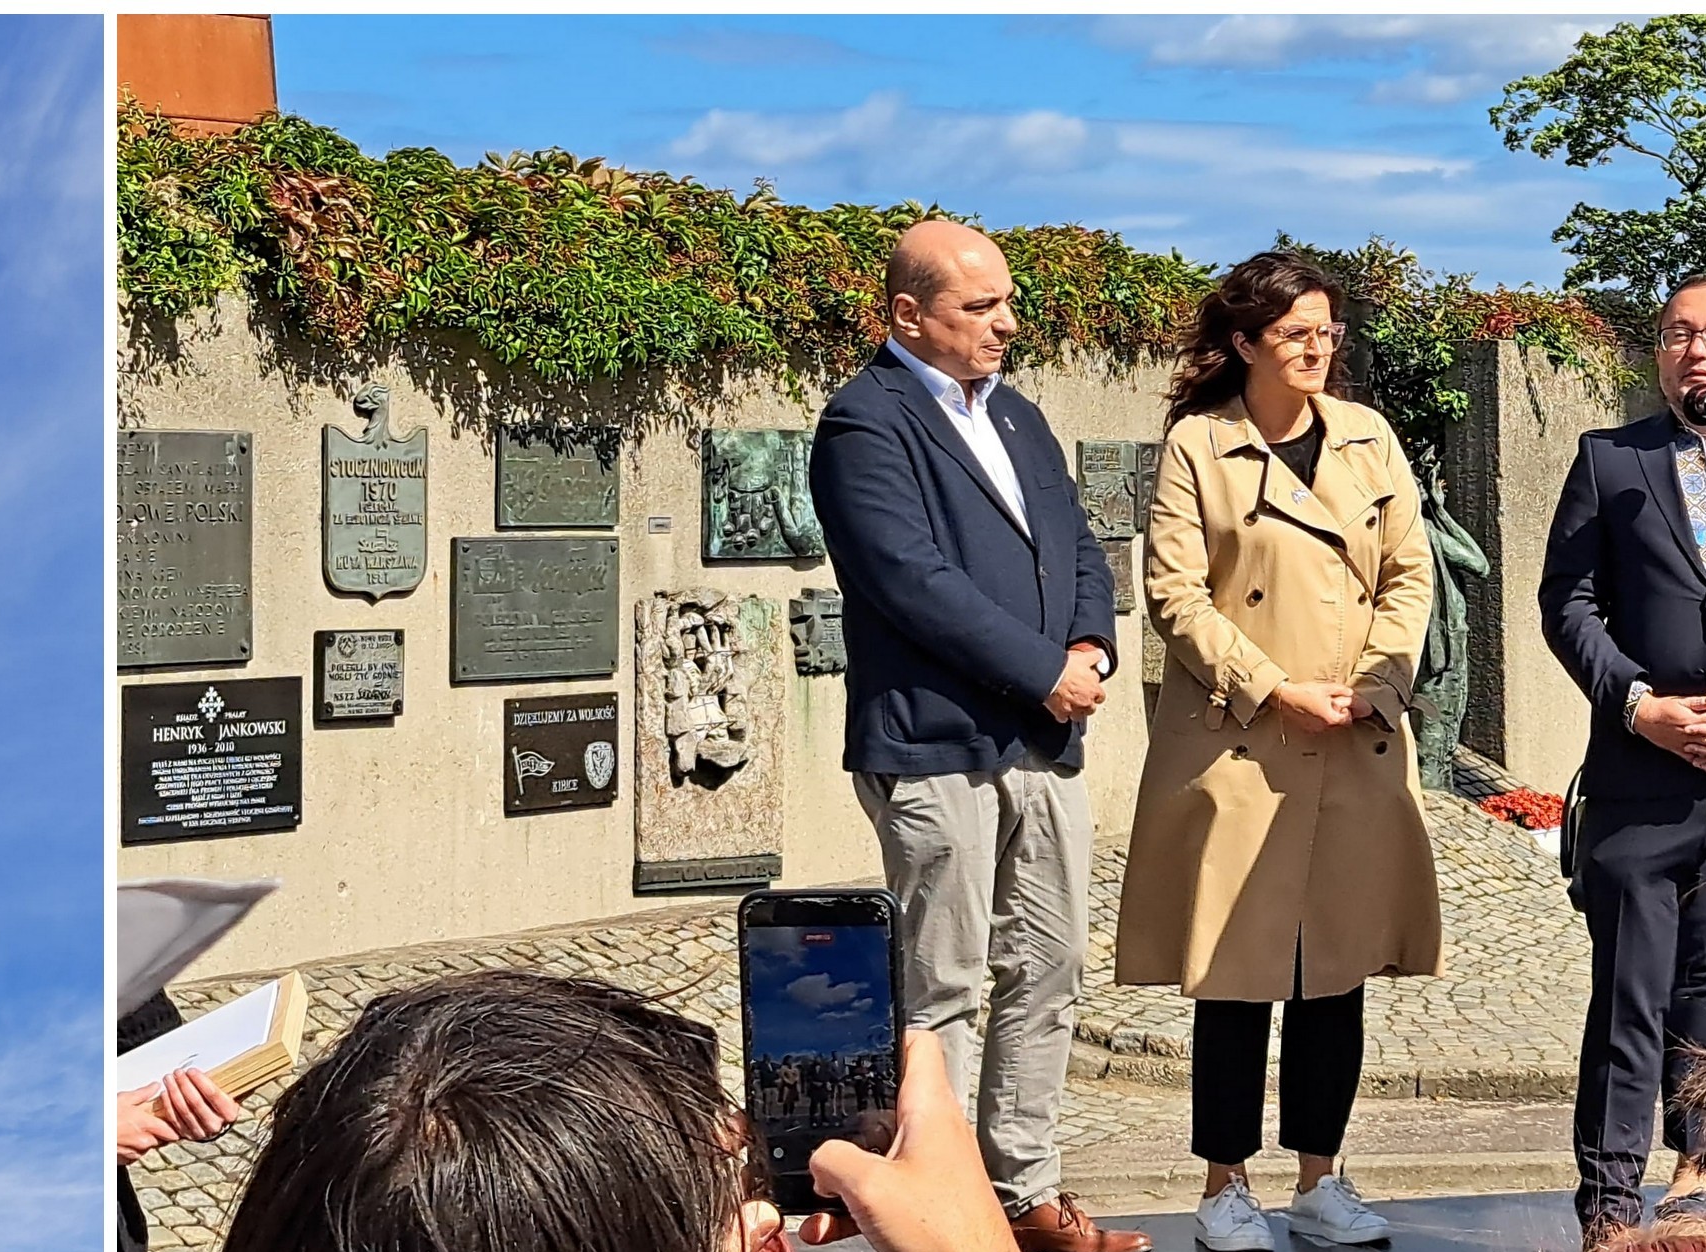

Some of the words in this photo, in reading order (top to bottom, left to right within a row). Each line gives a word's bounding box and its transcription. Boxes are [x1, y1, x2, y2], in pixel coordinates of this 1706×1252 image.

[361, 480, 398, 501] 1970
[185, 501, 244, 524] POLSKI
[514, 709, 565, 726] DZIĘKUJEMY
[566, 709, 577, 722] ZA
[578, 705, 615, 721] WOLNOŚĆ
[153, 725, 204, 742] HENRYK
[219, 721, 286, 740] JANKOWSKI
[188, 744, 206, 755] 1936
[214, 741, 234, 753] 2010
